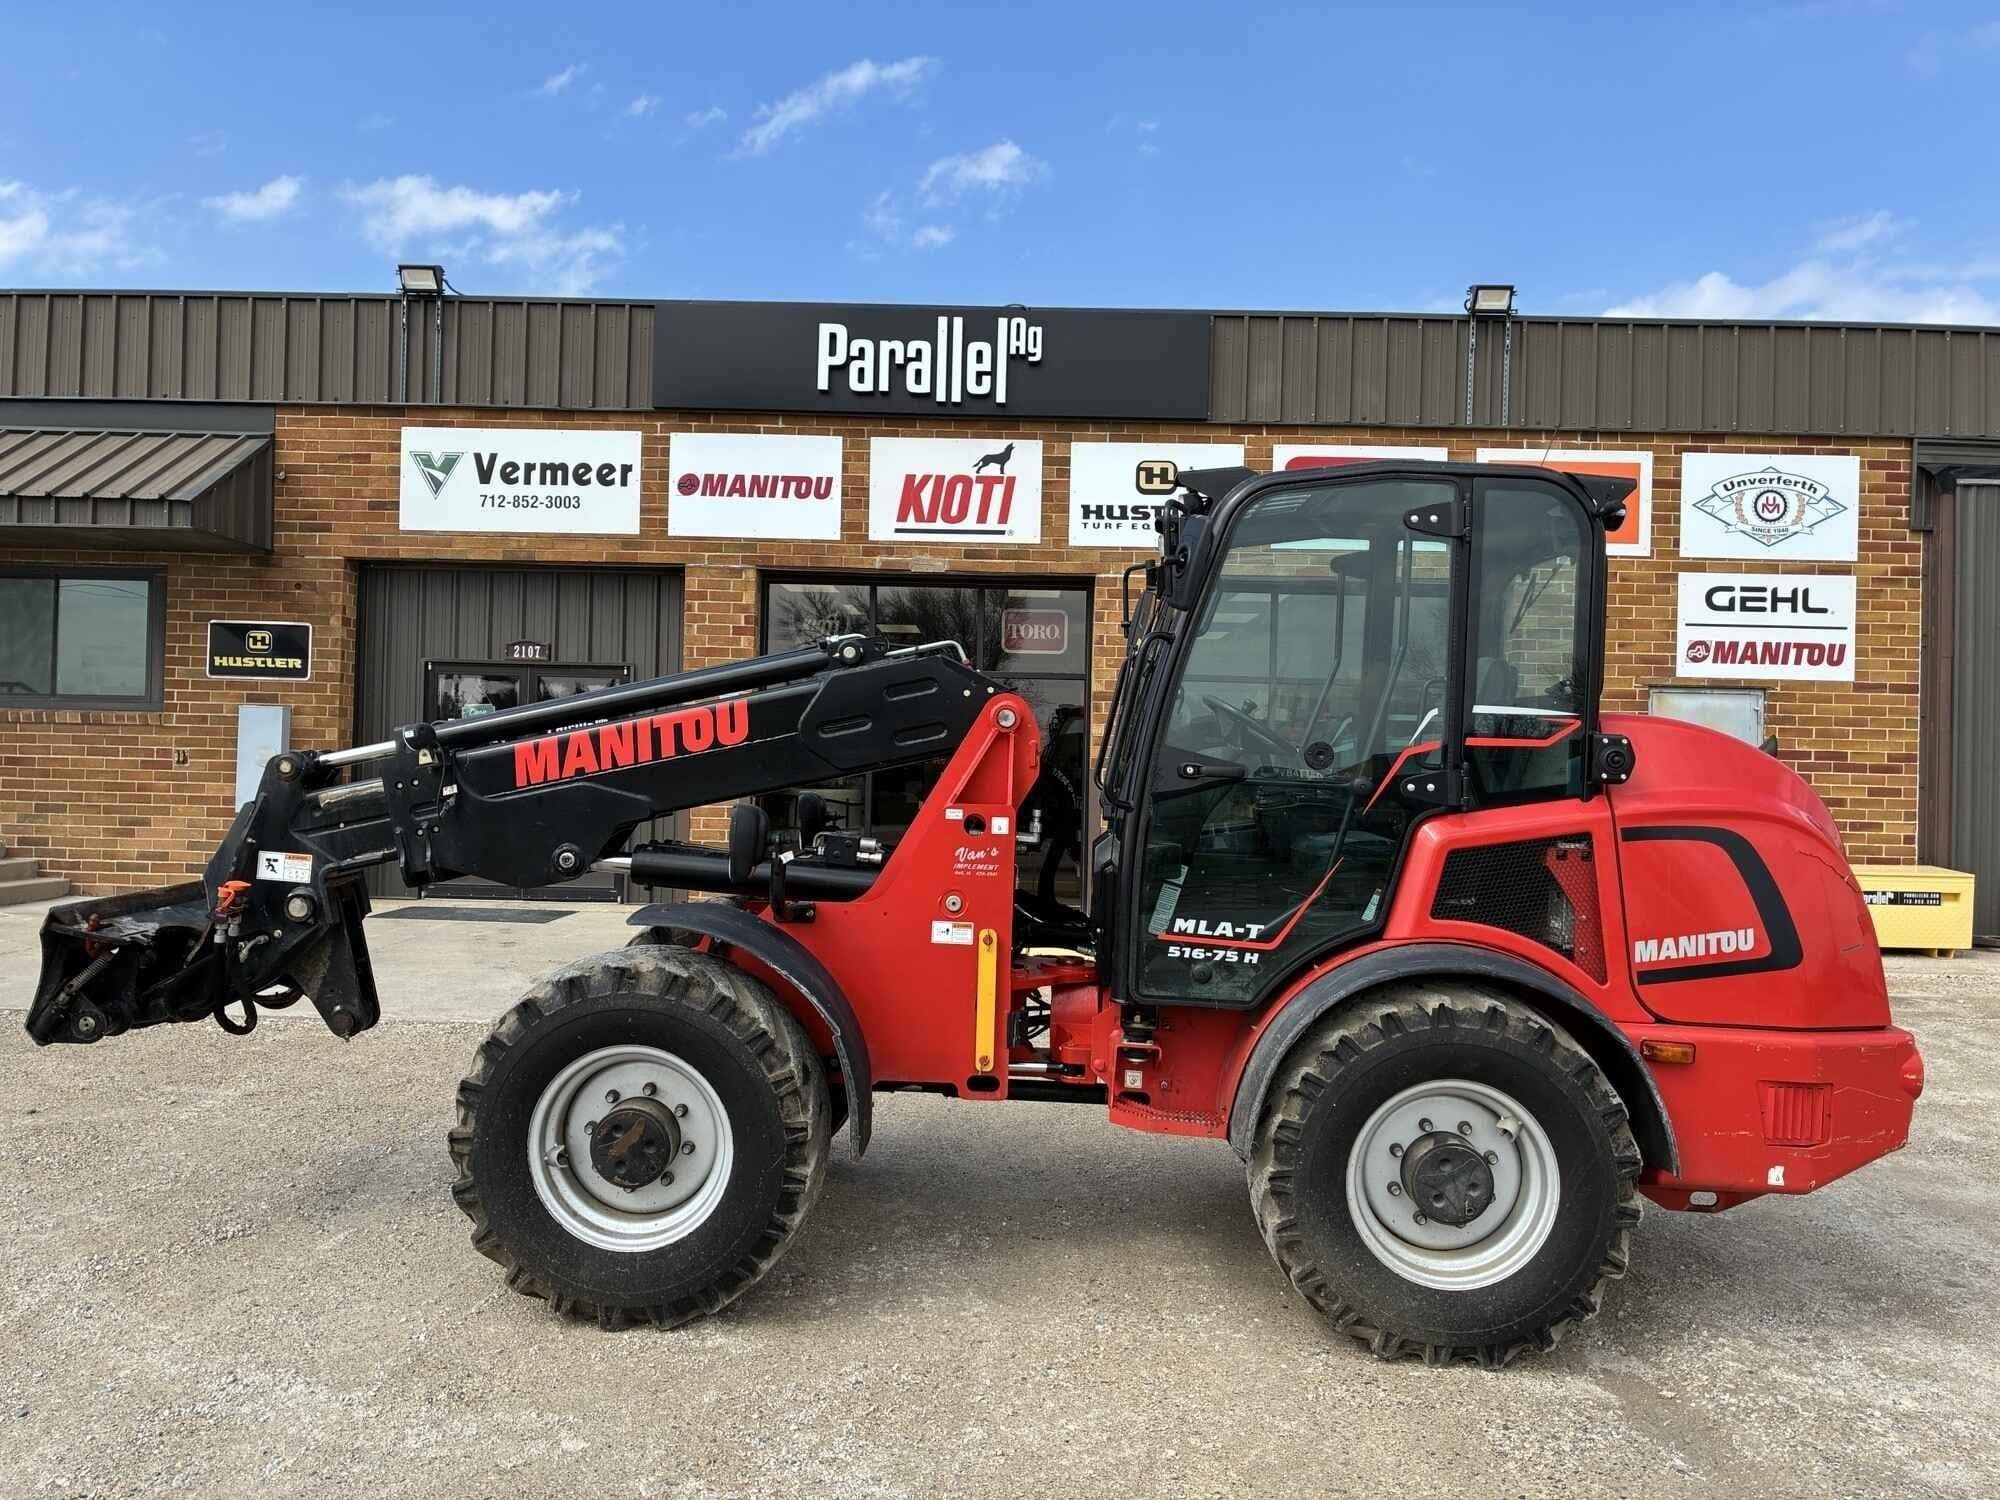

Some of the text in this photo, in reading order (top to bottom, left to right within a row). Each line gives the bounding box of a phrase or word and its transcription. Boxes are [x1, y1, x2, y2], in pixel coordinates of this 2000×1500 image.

[817, 316, 1043, 403] Parallel Ag
[473, 452, 633, 487] Vermeer
[700, 473, 834, 500] MANITOU
[1723, 475, 1818, 495] Unverferth
[479, 494, 581, 509] 712-852-3003
[896, 474, 1017, 525] KIOTI
[1081, 504, 1166, 521] HUST
[1082, 522, 1125, 530] TURF
[1752, 526, 1772, 534] SINCE
[1705, 586, 1828, 614] GEHL
[1007, 623, 1061, 640] TORO
[513, 645, 541, 659] 2107
[1712, 640, 1847, 667] MANITOU
[213, 656, 302, 669] HUSTLER
[513, 699, 749, 788] MANITOU
[955, 846, 999, 862] Van's
[953, 863, 999, 871] IMPLEMENT
[1173, 918, 1265, 939] MLA-T
[1167, 945, 1259, 964] 516-75 H
[1634, 927, 1754, 963] MANITOU
